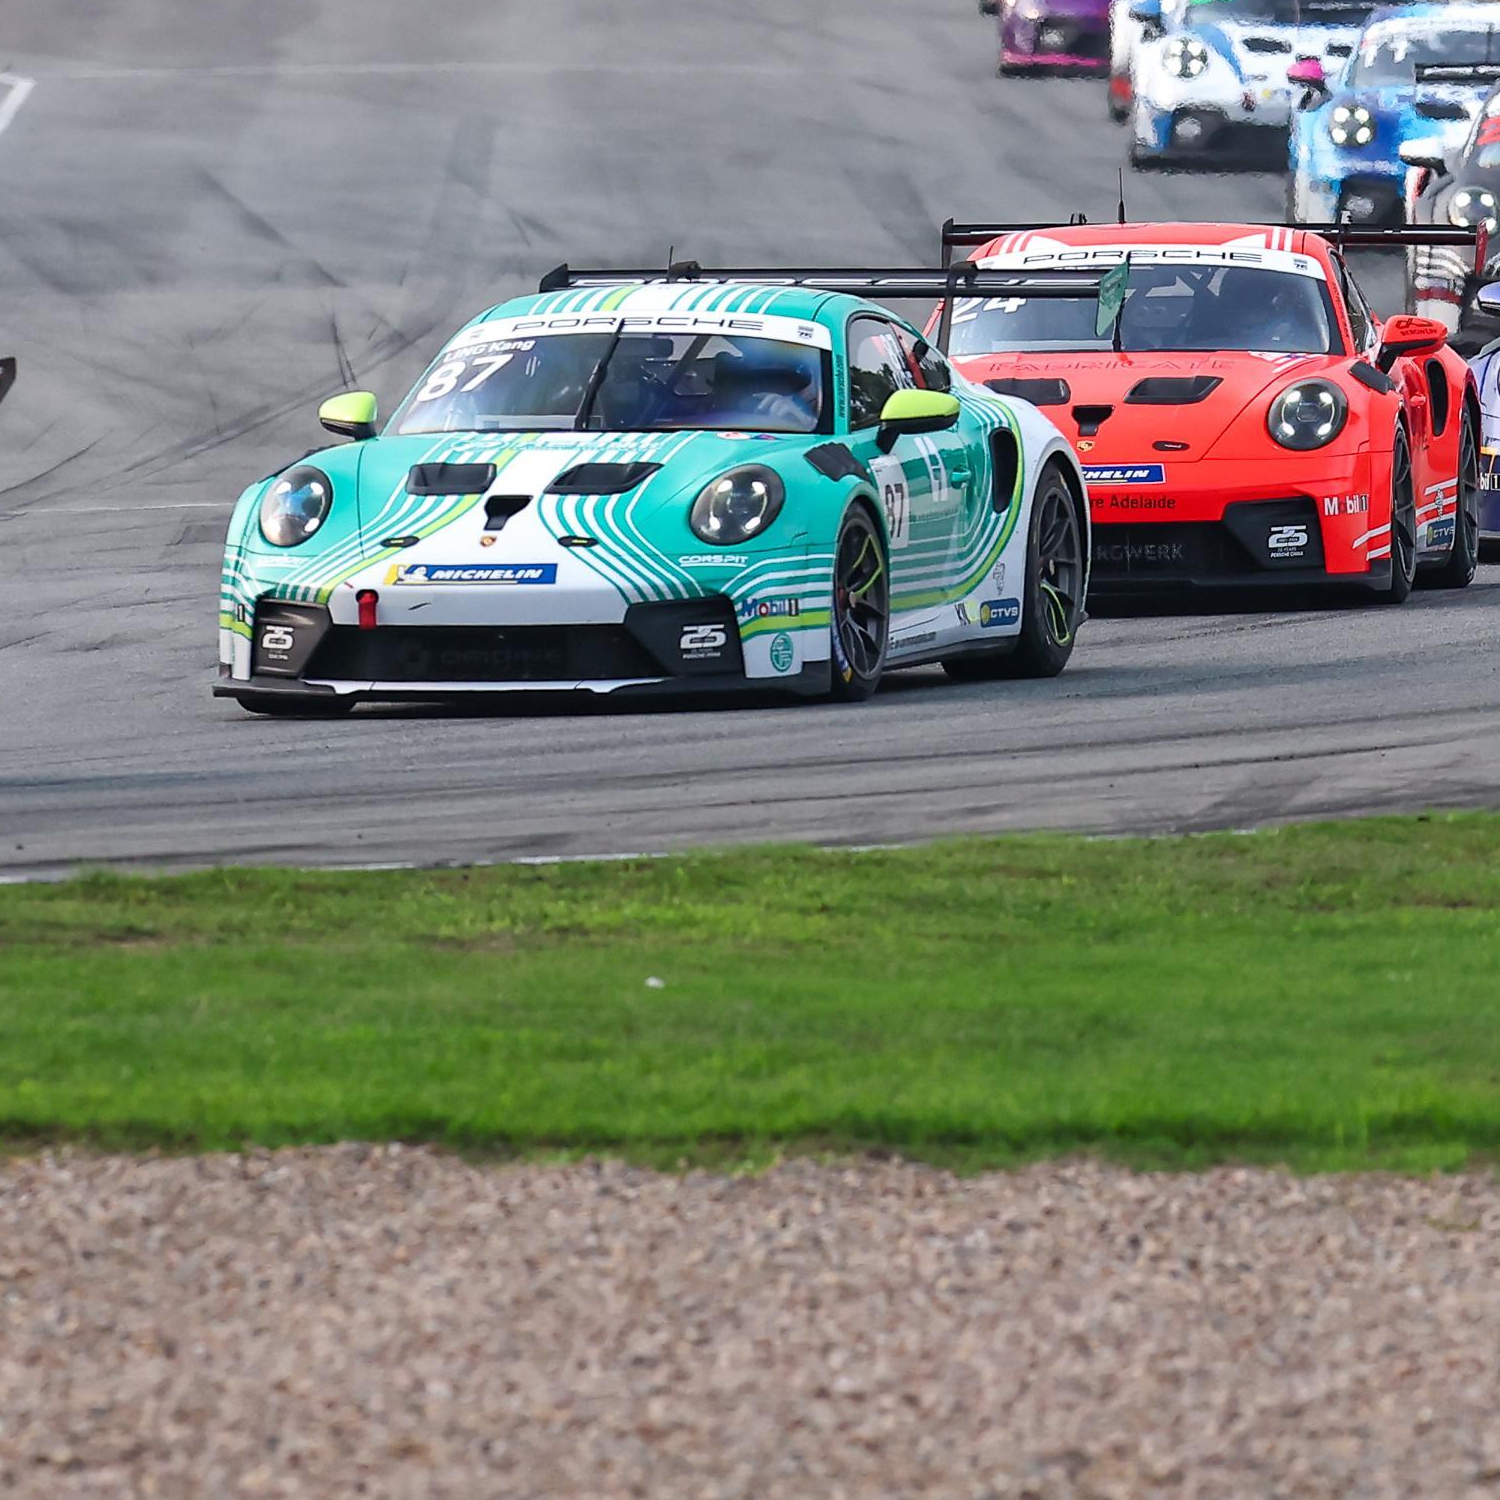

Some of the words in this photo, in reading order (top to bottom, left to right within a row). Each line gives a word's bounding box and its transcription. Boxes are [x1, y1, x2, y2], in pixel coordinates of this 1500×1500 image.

[1023, 250, 1263, 264] PORSCHE
[511, 316, 765, 332] PORSCHE
[491, 337, 536, 353] Kang
[416, 353, 515, 402] 87
[1479, 472, 1490, 491] bil
[1109, 495, 1176, 509] Adelaide
[884, 483, 905, 539] 87
[1095, 543, 1184, 560] RGWERK
[430, 568, 544, 580] MICHELIN
[990, 604, 1019, 619] CTVS
